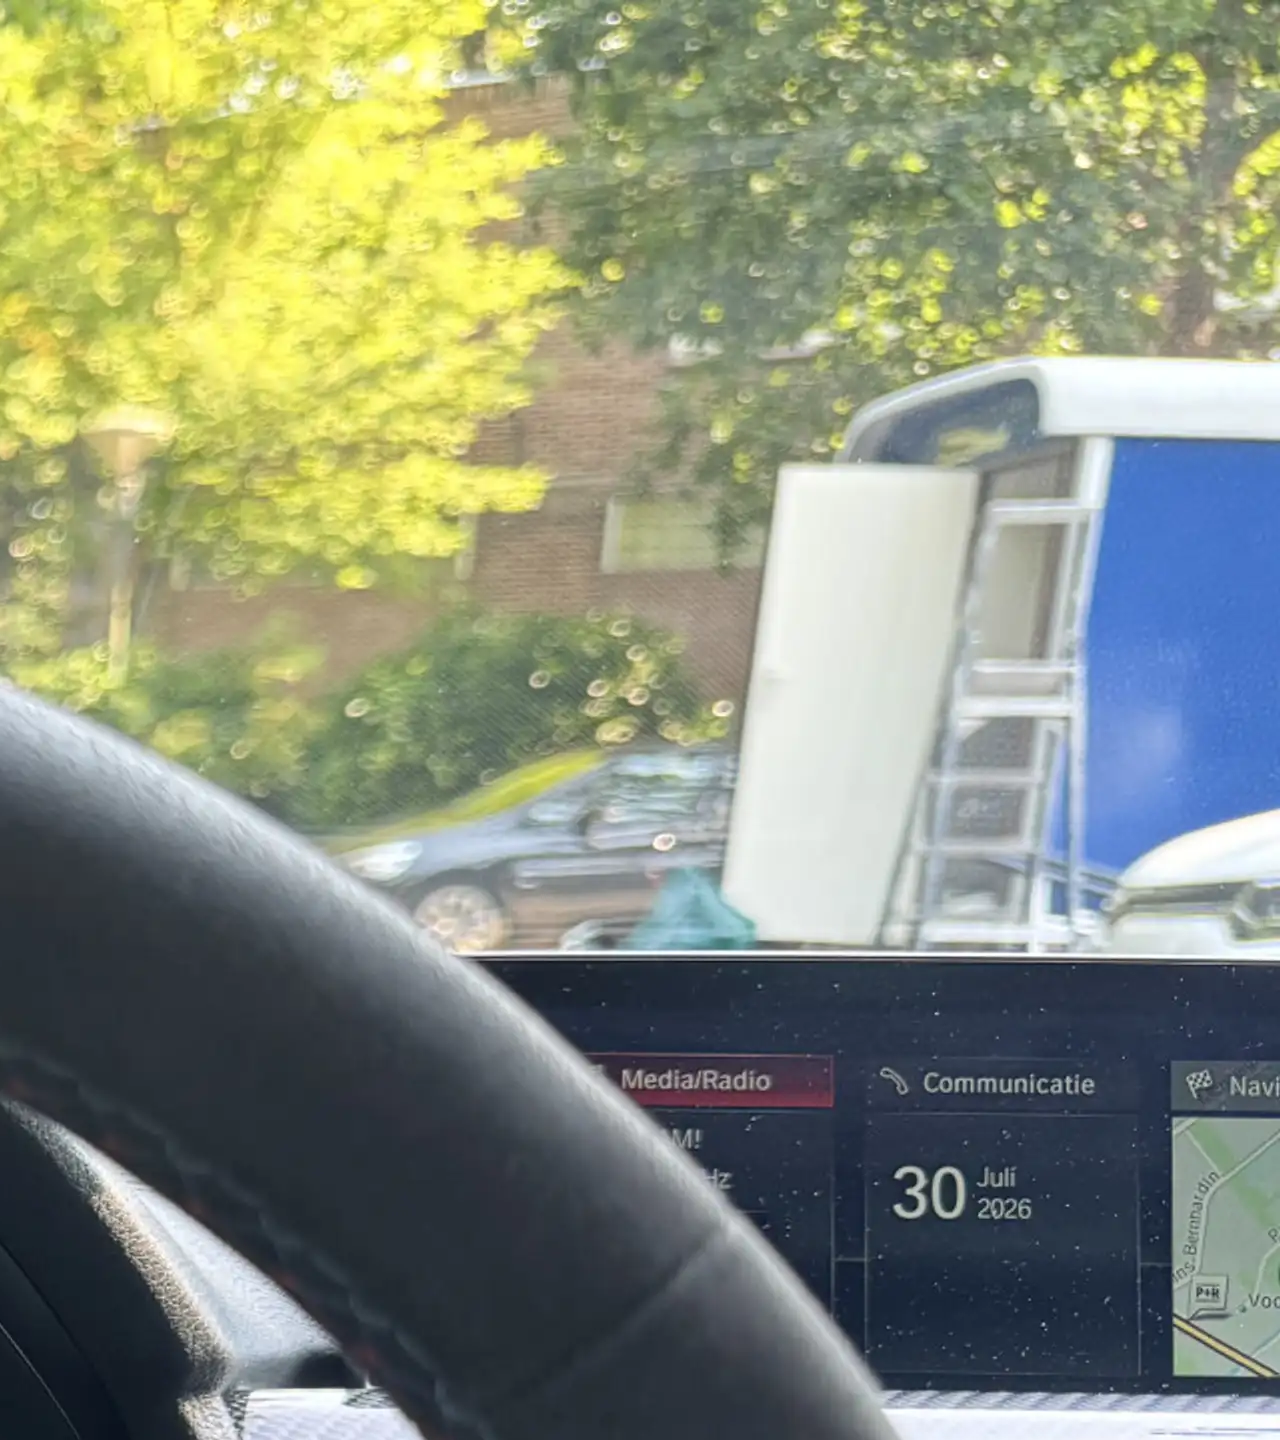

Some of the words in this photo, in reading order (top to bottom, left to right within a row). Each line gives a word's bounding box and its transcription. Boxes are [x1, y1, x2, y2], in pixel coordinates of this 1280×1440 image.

[621, 1069, 771, 1091] Media/Radio
[924, 1072, 1095, 1095] Communicatie
[1230, 1075, 1280, 1096] Navi
[976, 1167, 1017, 1187] Juli
[893, 1166, 966, 1219] 30
[977, 1198, 1032, 1219] 2026
